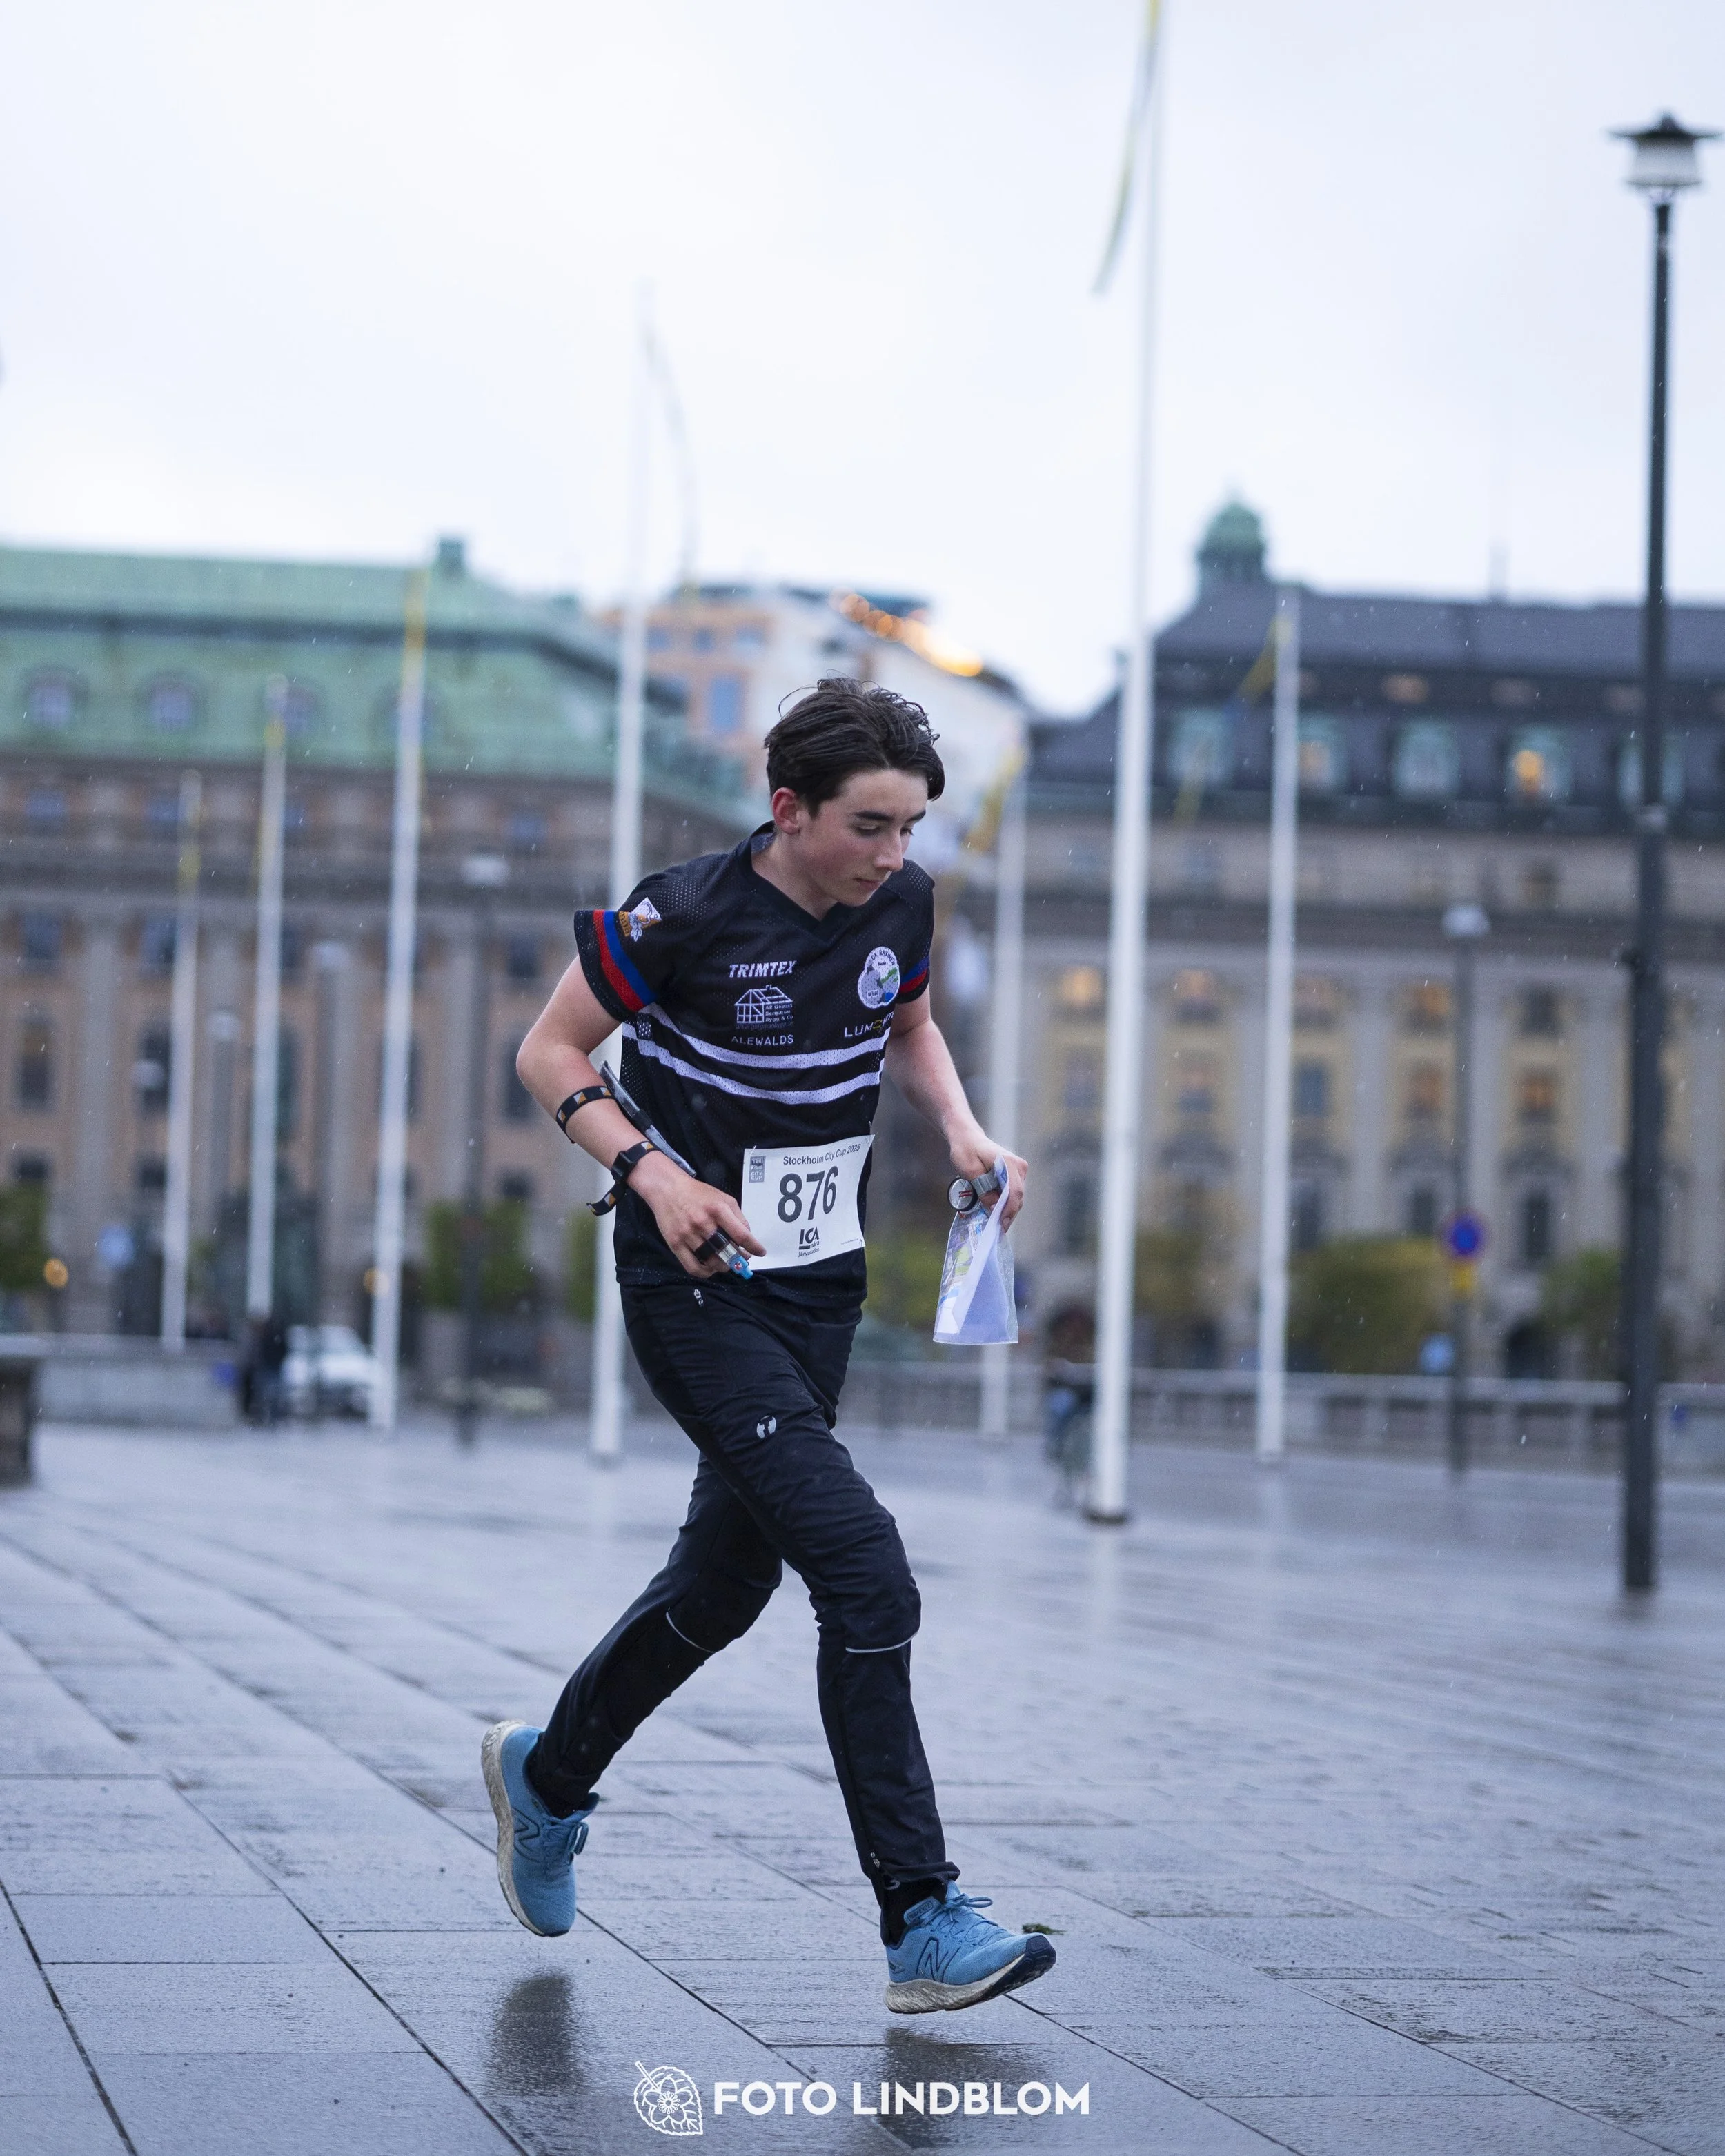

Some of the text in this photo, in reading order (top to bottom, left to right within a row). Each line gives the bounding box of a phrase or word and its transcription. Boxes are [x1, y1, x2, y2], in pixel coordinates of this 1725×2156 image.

[729, 960, 797, 978] TRIMTEX
[731, 1034, 793, 1046] ALEWALDS
[783, 1143, 861, 1165] Stockholm City Cup 2025
[777, 1165, 839, 1223] 876
[799, 1226, 820, 1245] ICA
